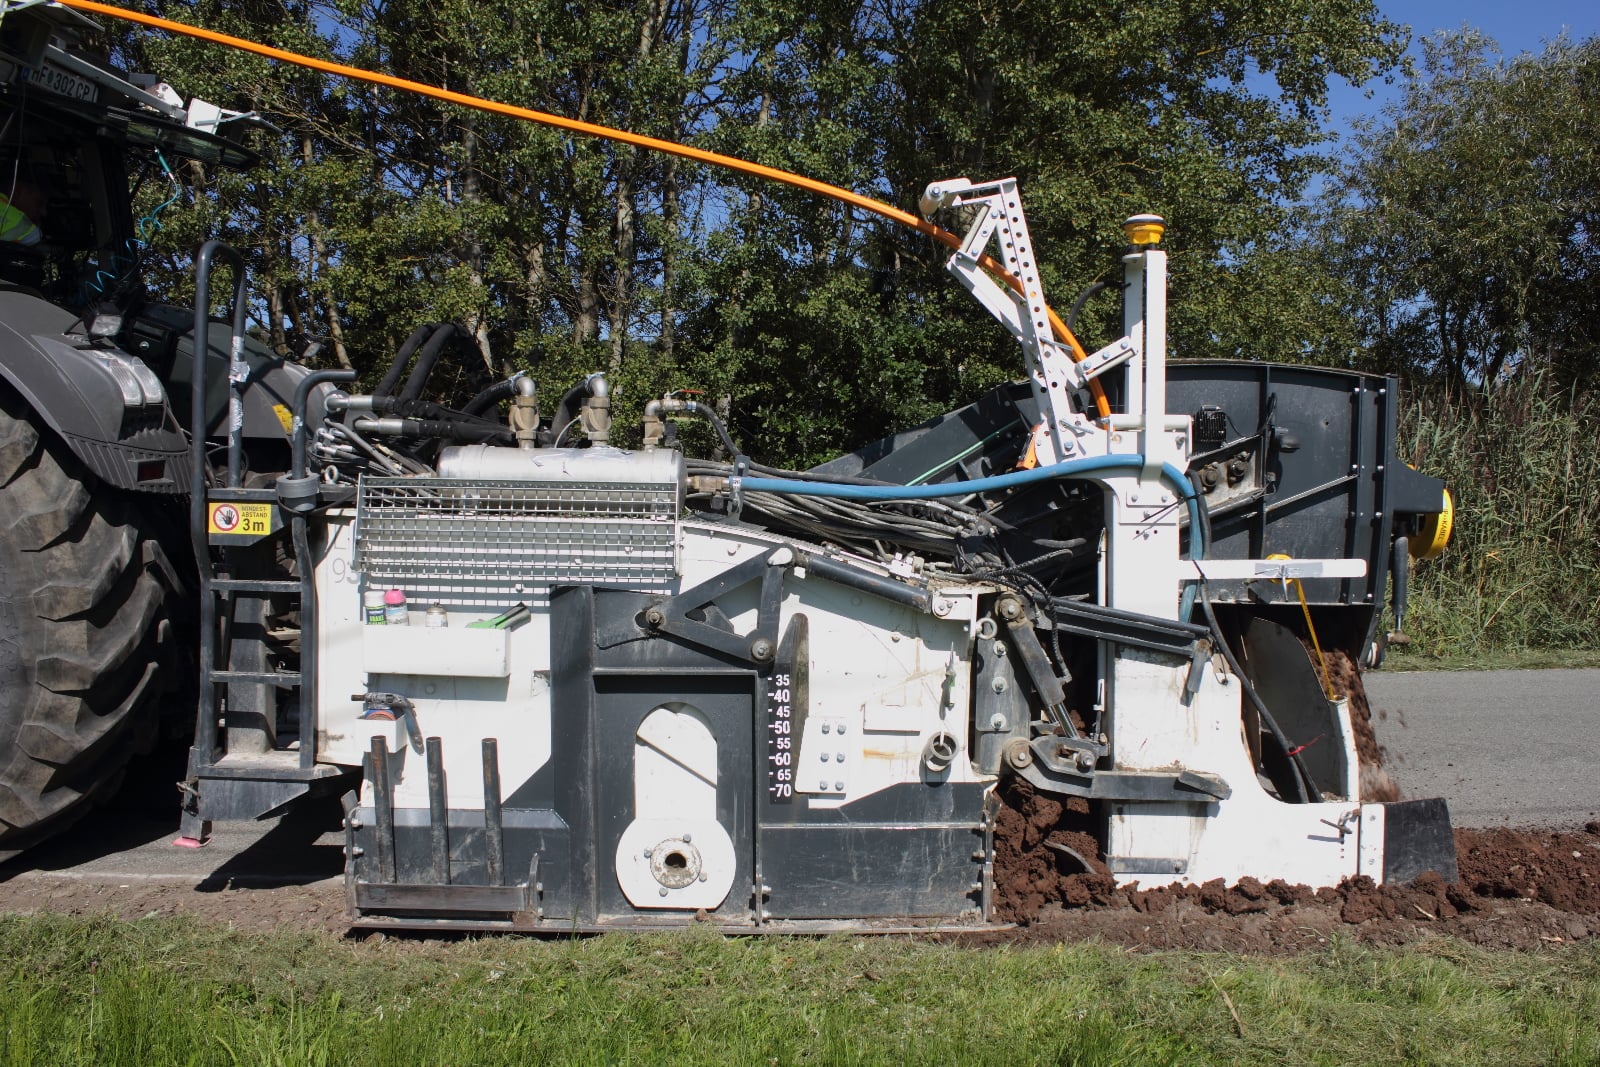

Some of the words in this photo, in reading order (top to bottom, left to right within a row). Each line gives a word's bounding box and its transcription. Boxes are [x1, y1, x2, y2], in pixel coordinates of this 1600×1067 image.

[53, 72, 75, 96] 302
[242, 518, 250, 531] 3
[253, 521, 264, 531] m
[775, 674, 790, 686] 35
[776, 706, 790, 718] 45
[776, 737, 791, 749] 55
[777, 769, 791, 781] 65
